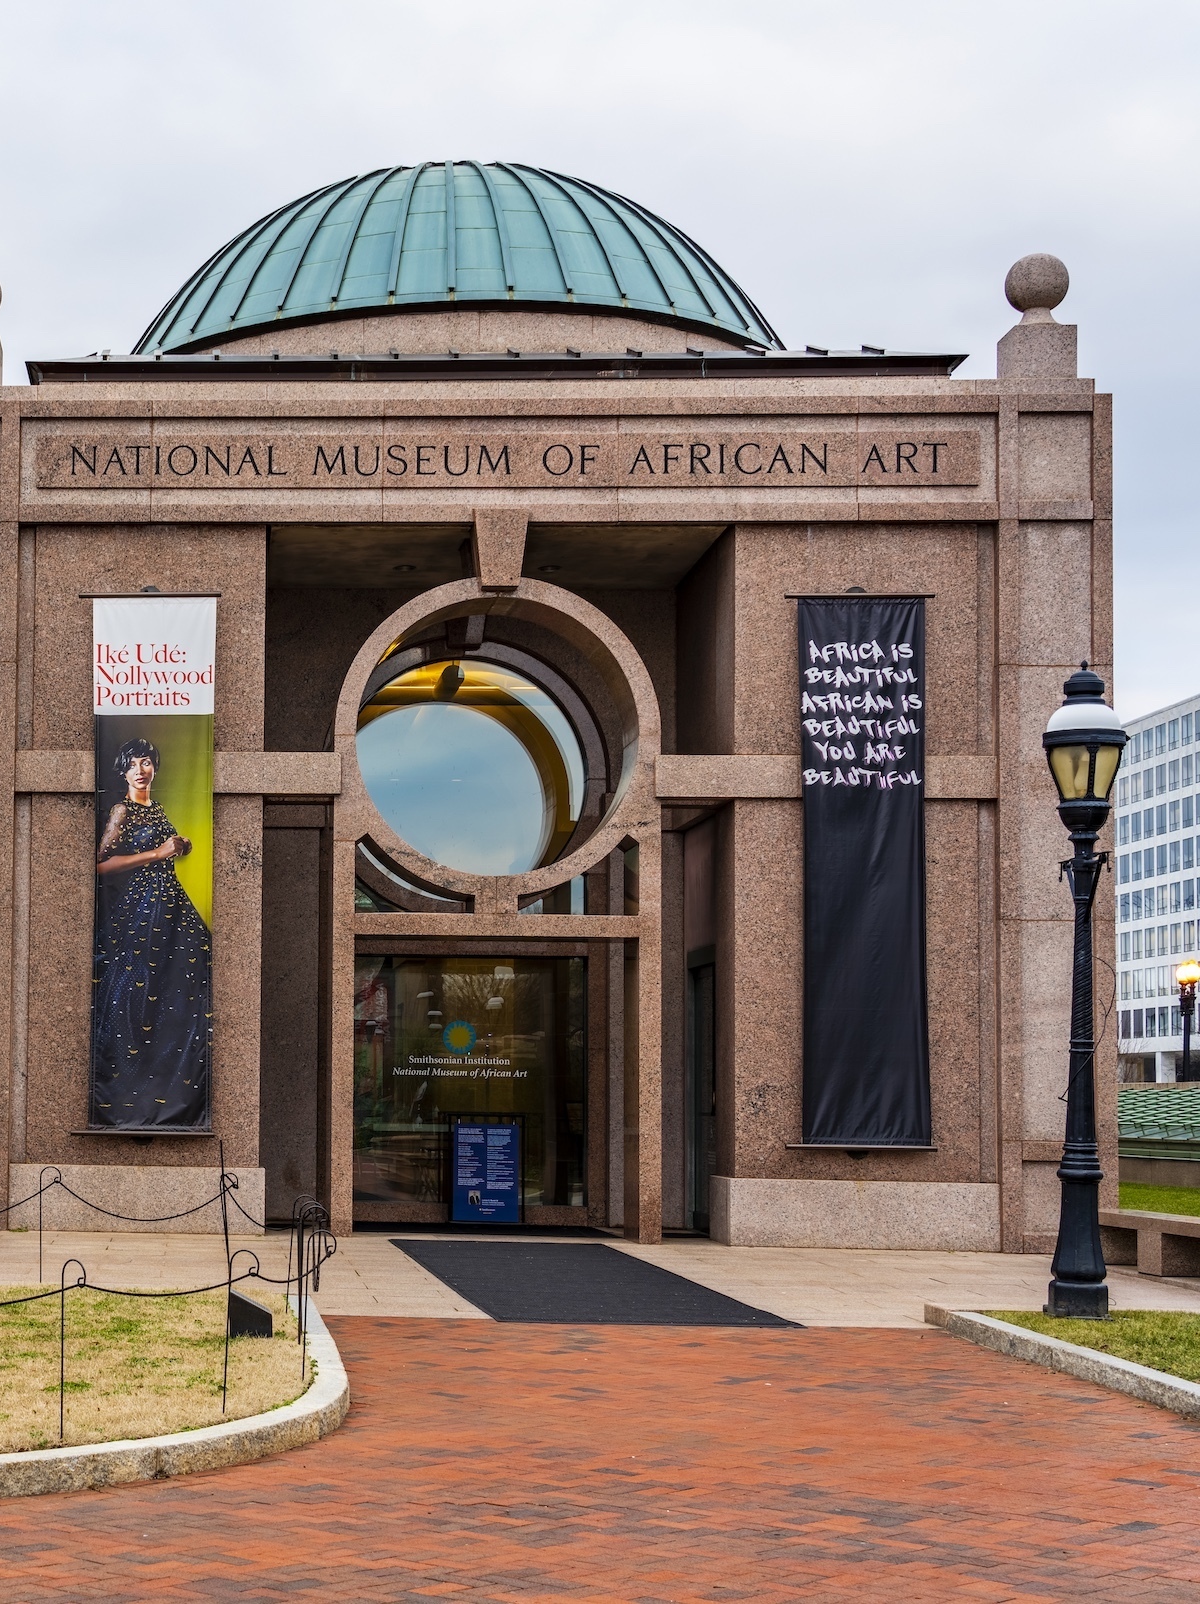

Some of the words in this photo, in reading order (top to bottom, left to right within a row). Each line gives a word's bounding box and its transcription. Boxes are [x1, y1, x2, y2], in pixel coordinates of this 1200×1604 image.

[69, 444, 289, 477] NATIONAL
[312, 443, 512, 477] MUSEUM
[542, 443, 601, 477] OF
[628, 442, 829, 476] AFRICAN
[861, 442, 949, 475] ART
[96, 643, 129, 664] Iké
[135, 643, 187, 664] Udé:
[96, 664, 213, 691] Nollywood
[96, 686, 191, 706] Portraits
[812, 740, 857, 763] YOU
[862, 741, 907, 767] ARE
[408, 1054, 463, 1065] Smithsonian
[464, 1056, 511, 1066] Institution
[392, 1066, 431, 1076] National
[431, 1067, 468, 1077] Museum
[469, 1067, 480, 1080] of
[479, 1068, 512, 1080] African
[512, 1069, 528, 1078] Art
